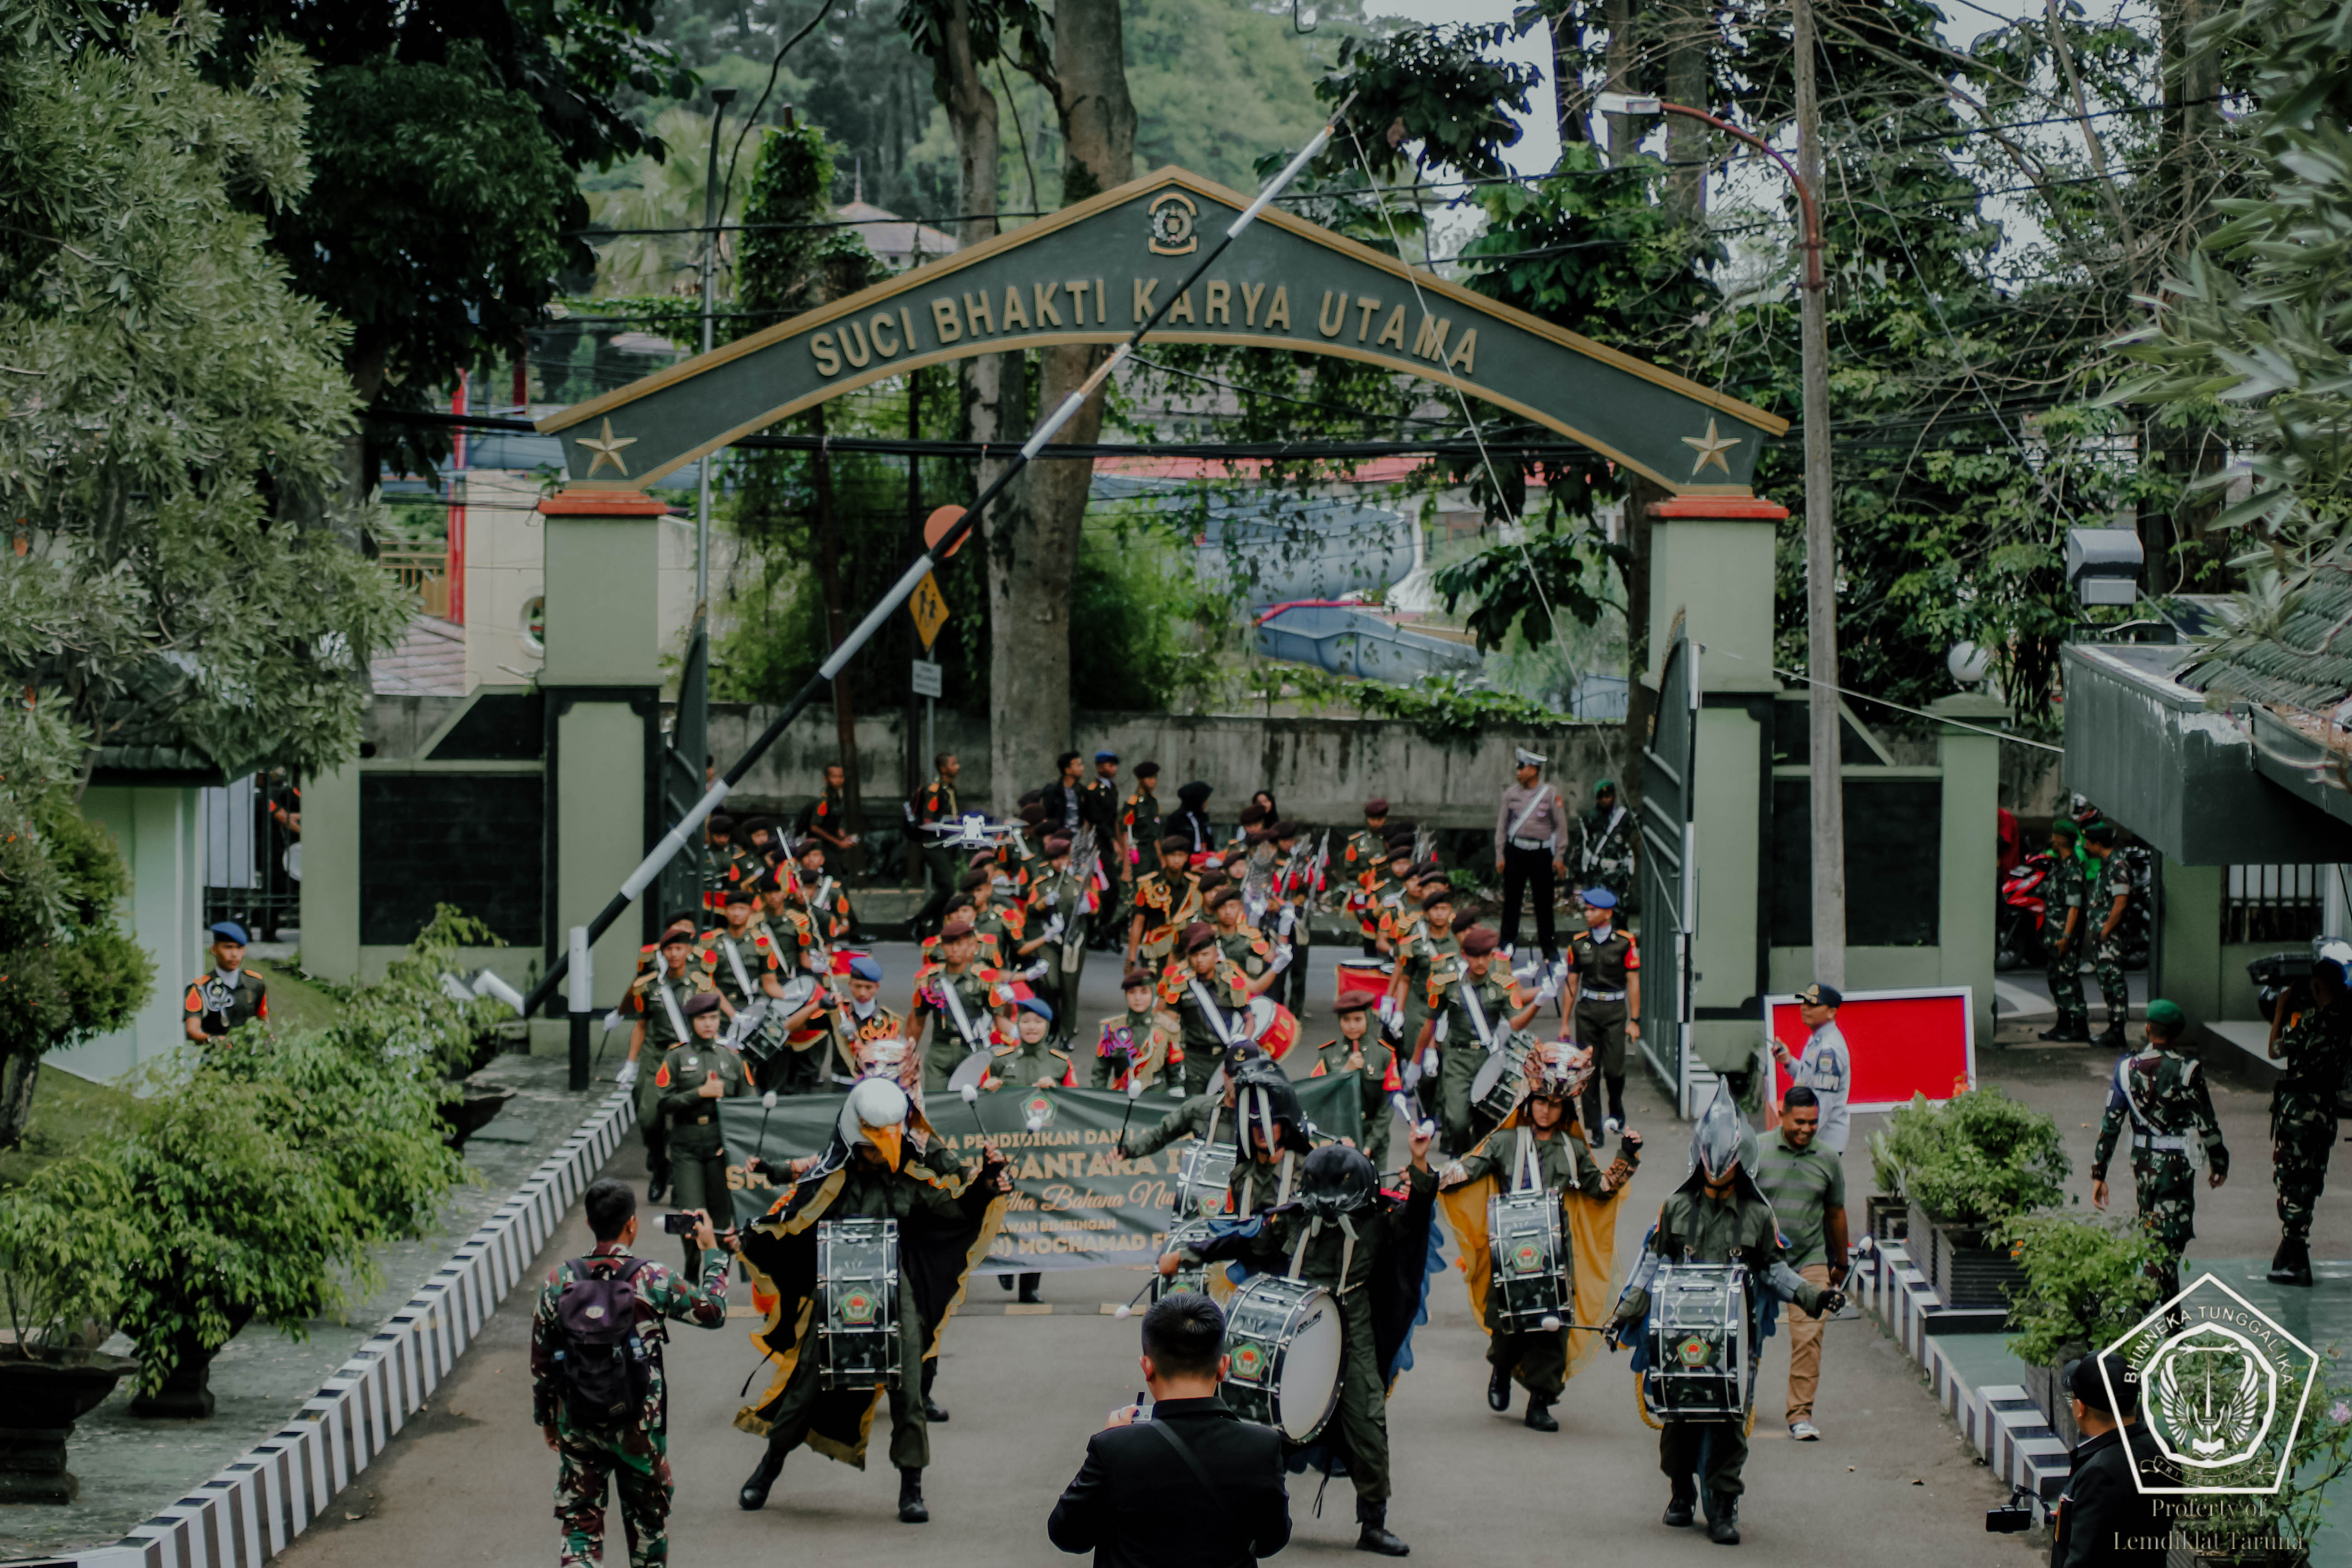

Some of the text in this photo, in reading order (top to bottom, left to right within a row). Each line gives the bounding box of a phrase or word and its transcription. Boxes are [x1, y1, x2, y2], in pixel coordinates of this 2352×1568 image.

[810, 279, 1477, 376] SUCI BHAKTI KARYA UTAMA
[1085, 1130, 1122, 1144] DAN
[1041, 1184, 1125, 1211] Bahana
[1040, 1219, 1117, 1232] BIMBINGAN
[1019, 1233, 1147, 1254] MOCHAMAD
